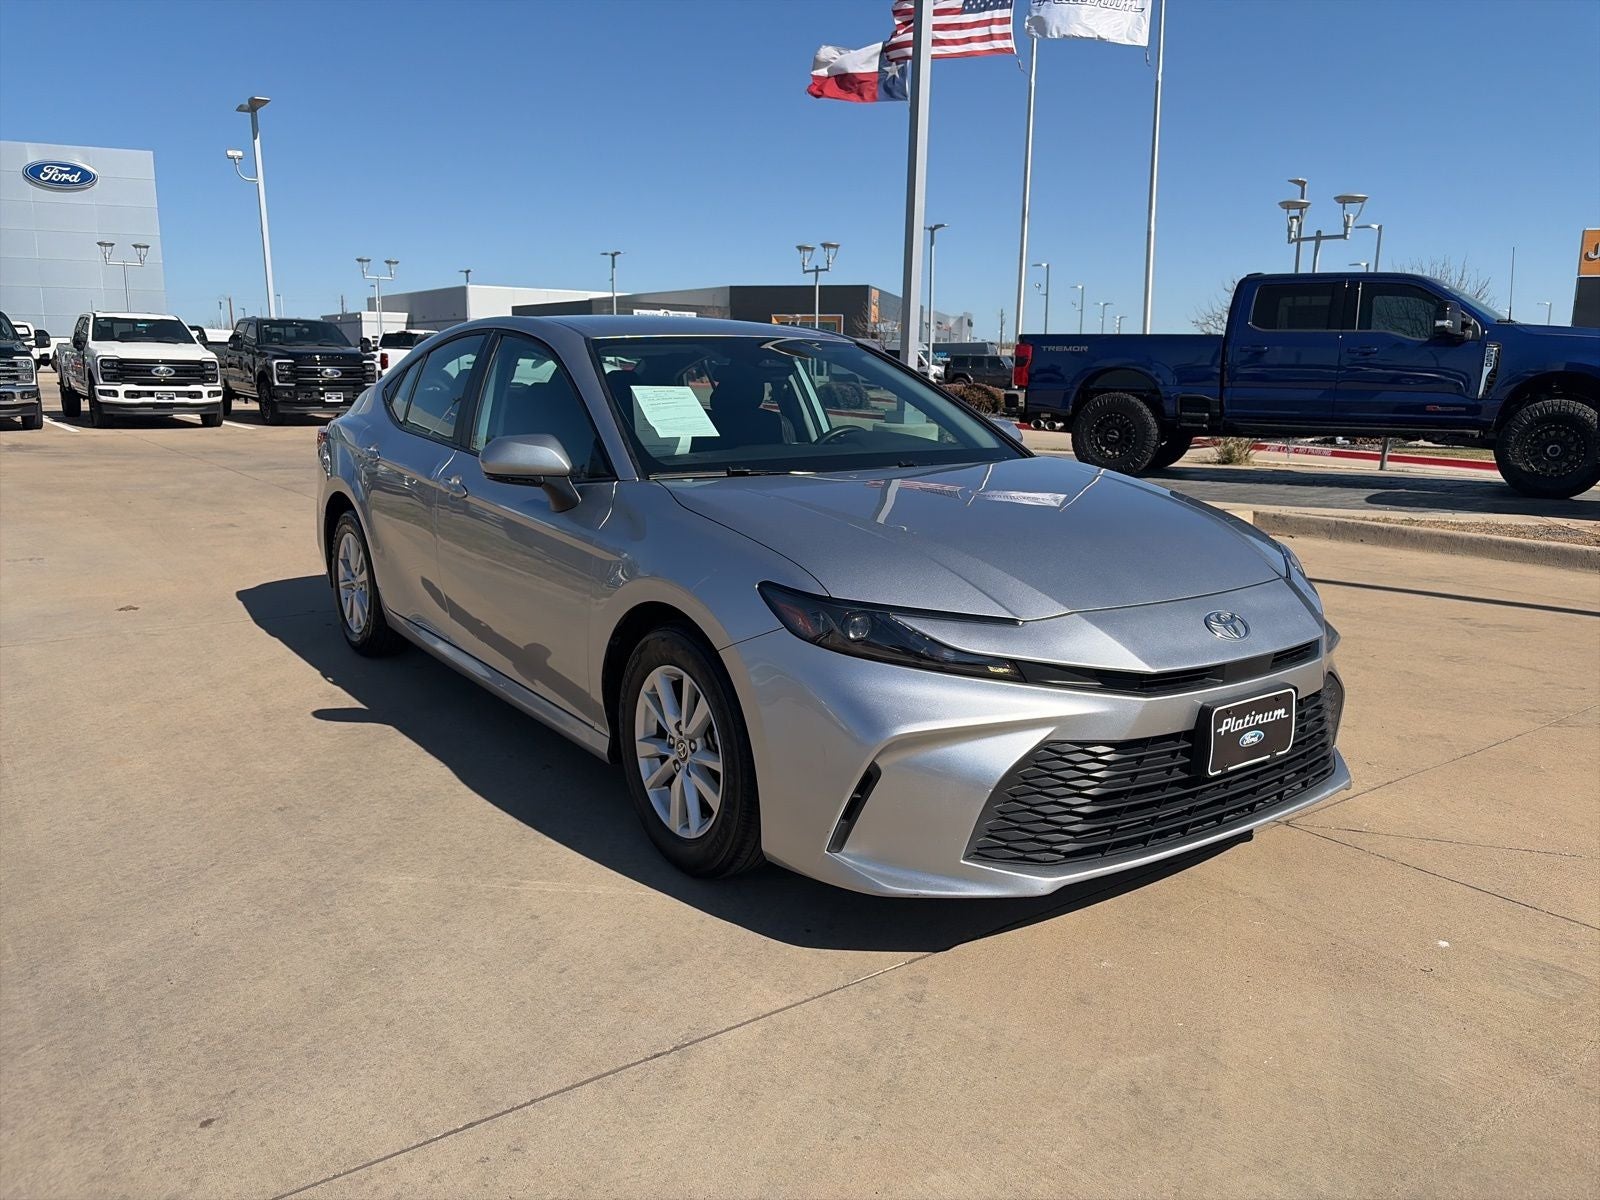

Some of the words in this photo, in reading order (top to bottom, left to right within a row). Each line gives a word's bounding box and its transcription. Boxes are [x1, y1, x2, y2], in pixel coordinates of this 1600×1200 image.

[40, 165, 81, 182] Ford
[1217, 708, 1289, 735] Platinum
[1243, 732, 1260, 744] Ford
